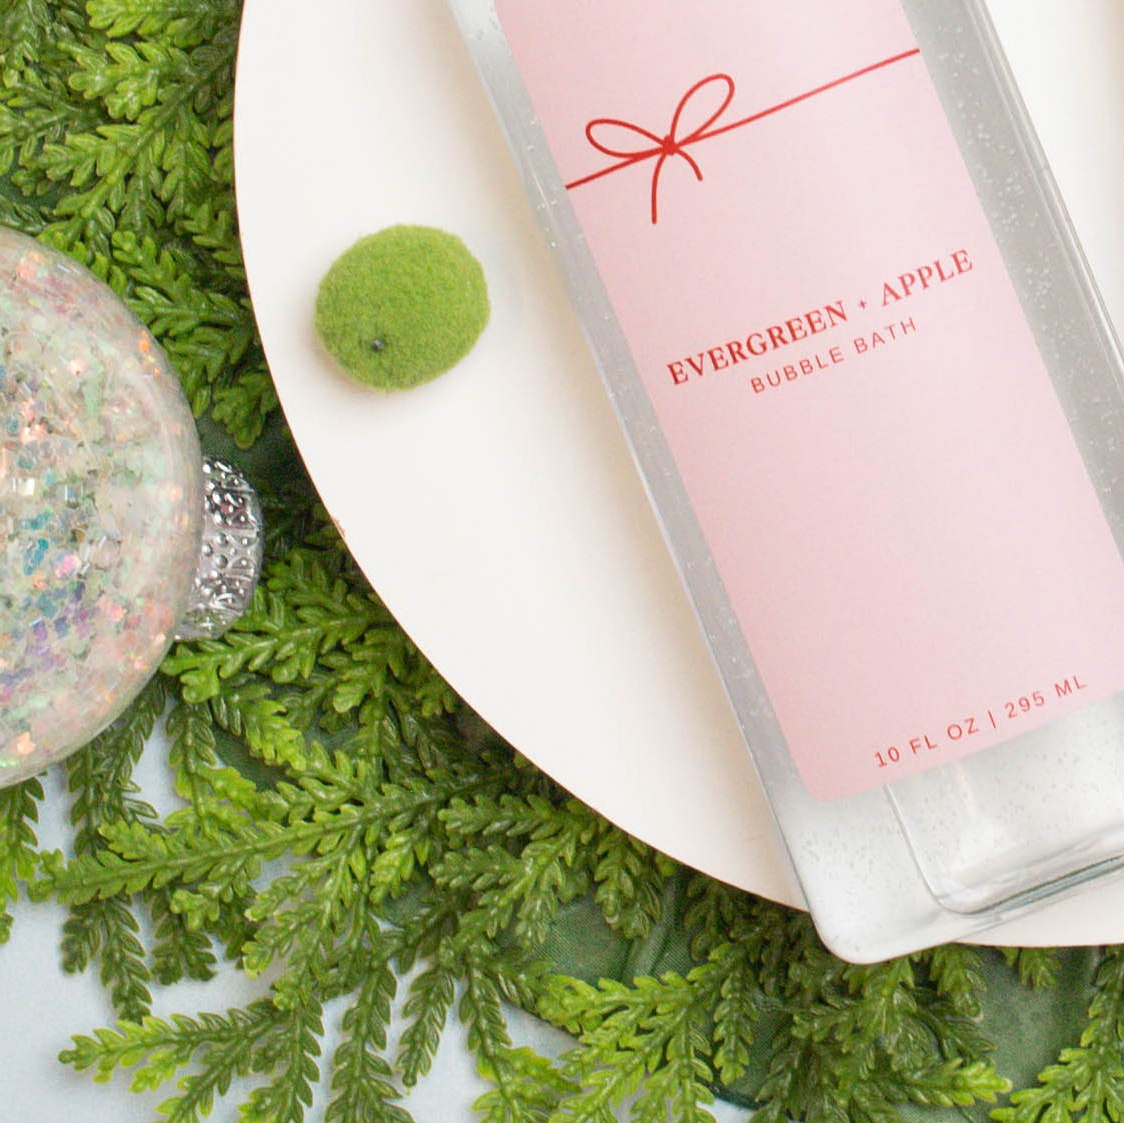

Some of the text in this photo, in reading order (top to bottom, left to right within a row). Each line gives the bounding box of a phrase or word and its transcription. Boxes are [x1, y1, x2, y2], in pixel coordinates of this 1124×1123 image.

[665, 249, 973, 387] EVERGREEN + APPLE
[749, 316, 917, 395] BUBBLE BATH
[874, 745, 900, 769] 10
[908, 734, 938, 755] FL
[946, 716, 980, 741] OZ
[1004, 690, 1045, 719] 295
[1053, 675, 1087, 699] ML
